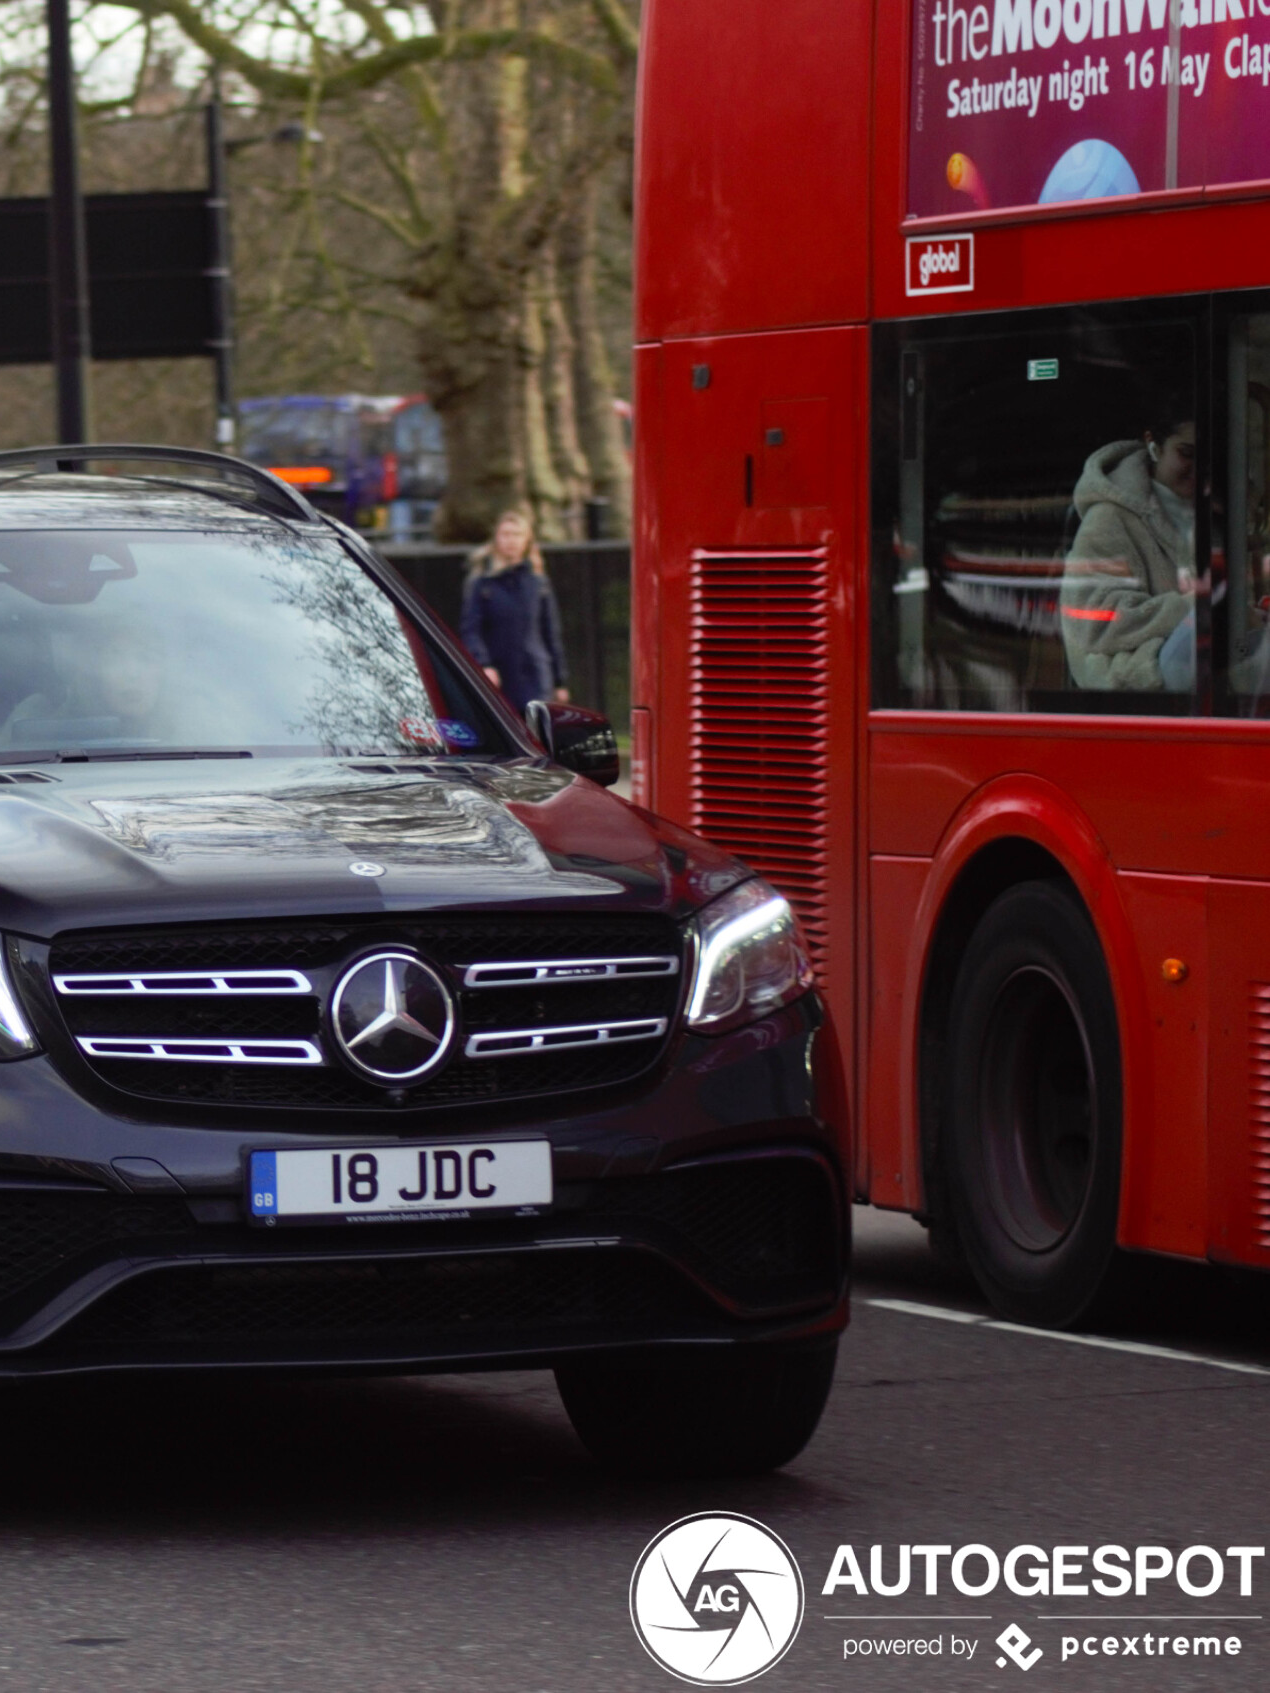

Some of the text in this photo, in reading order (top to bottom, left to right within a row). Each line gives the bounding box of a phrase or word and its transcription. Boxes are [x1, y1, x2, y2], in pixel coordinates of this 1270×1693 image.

[947, 68, 1042, 118] Saturday
[1048, 56, 1109, 111] night
[1125, 49, 1154, 90] 16
[1161, 46, 1210, 97] May
[919, 242, 960, 286] global
[254, 1193, 274, 1207] GB
[332, 1149, 496, 1204] 18 JDC
